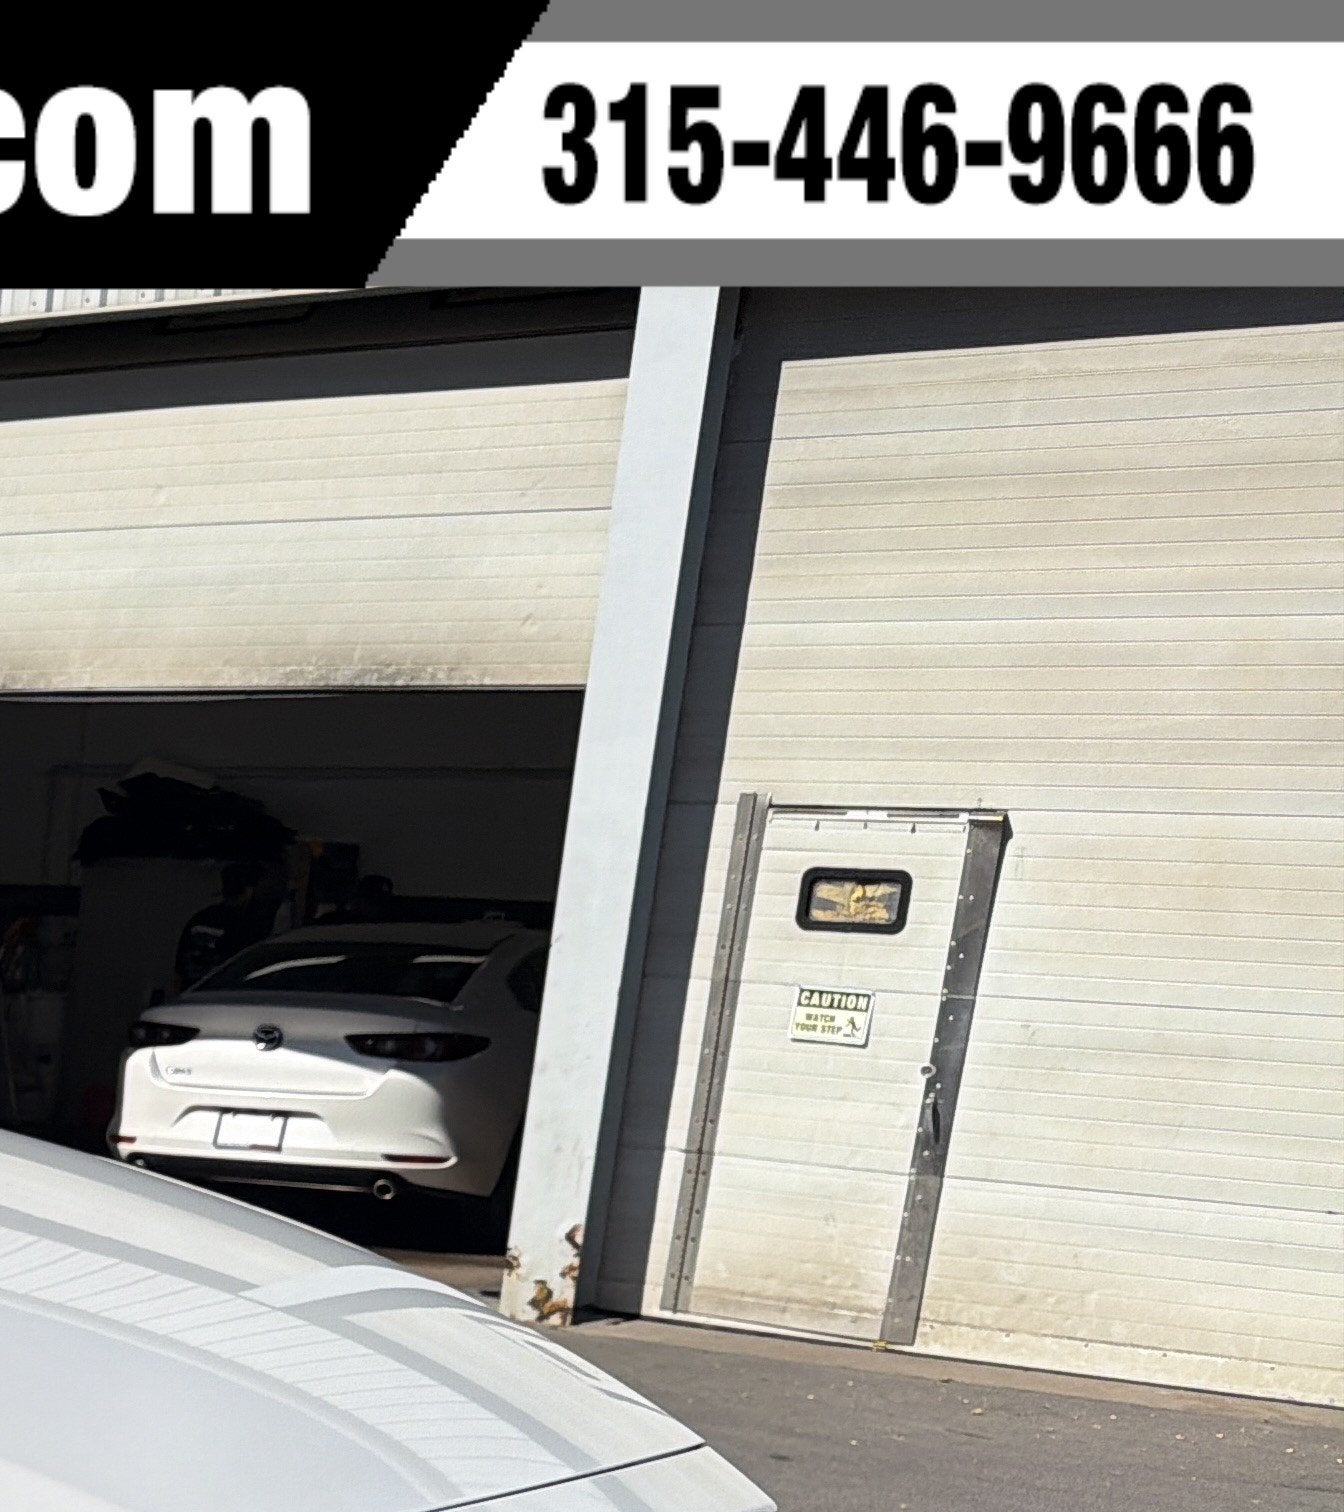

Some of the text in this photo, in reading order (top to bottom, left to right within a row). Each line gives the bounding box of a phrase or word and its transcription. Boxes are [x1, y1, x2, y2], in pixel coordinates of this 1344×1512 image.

[800, 990, 869, 1011] CAUTION
[805, 1013, 836, 1023] WATCH
[795, 1022, 843, 1035] YOUR STEP
